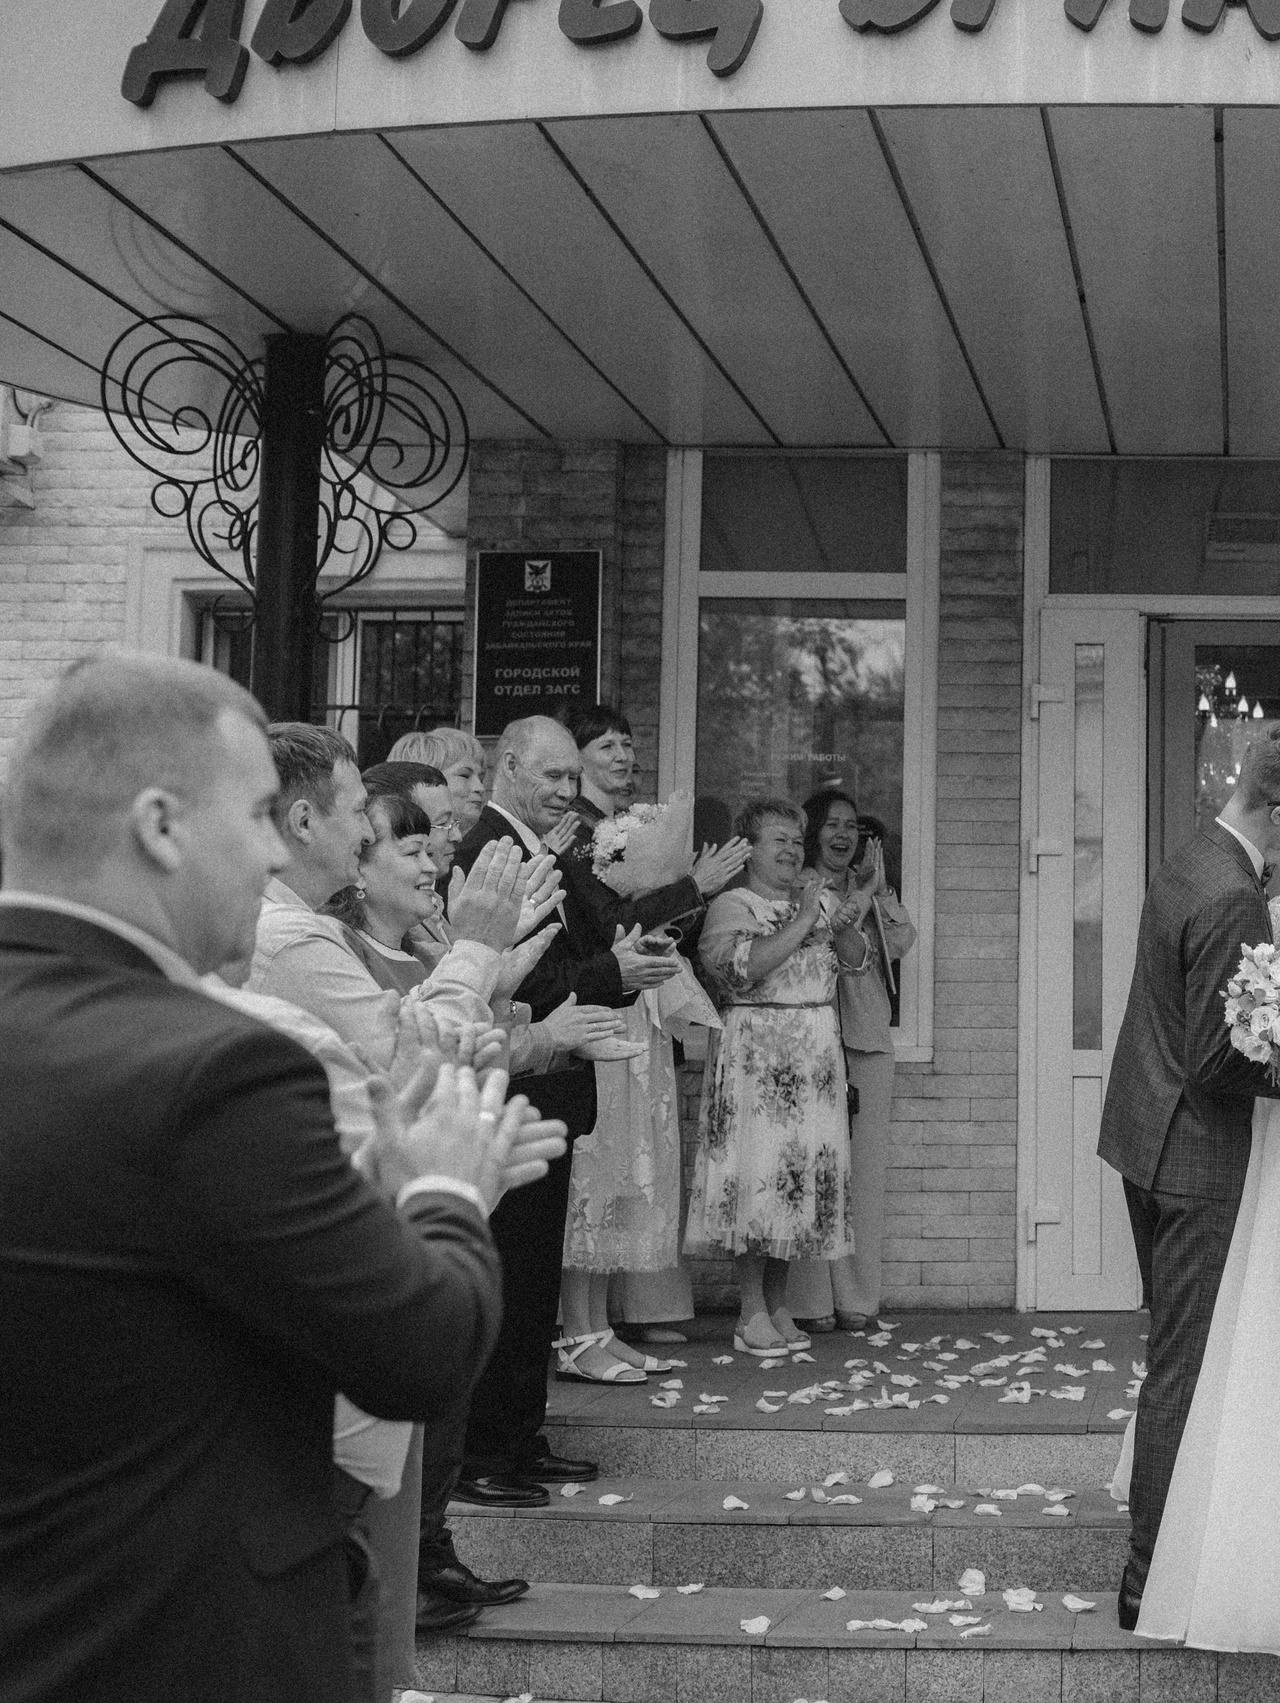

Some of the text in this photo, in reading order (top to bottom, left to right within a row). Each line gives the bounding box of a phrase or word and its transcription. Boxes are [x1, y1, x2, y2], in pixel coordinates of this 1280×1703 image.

[495, 666, 580, 679] ГОРОДСКОЙ
[494, 684, 580, 696] ОТДЕЛ ЗАГС
[807, 754, 846, 762] РАБОТЫ
